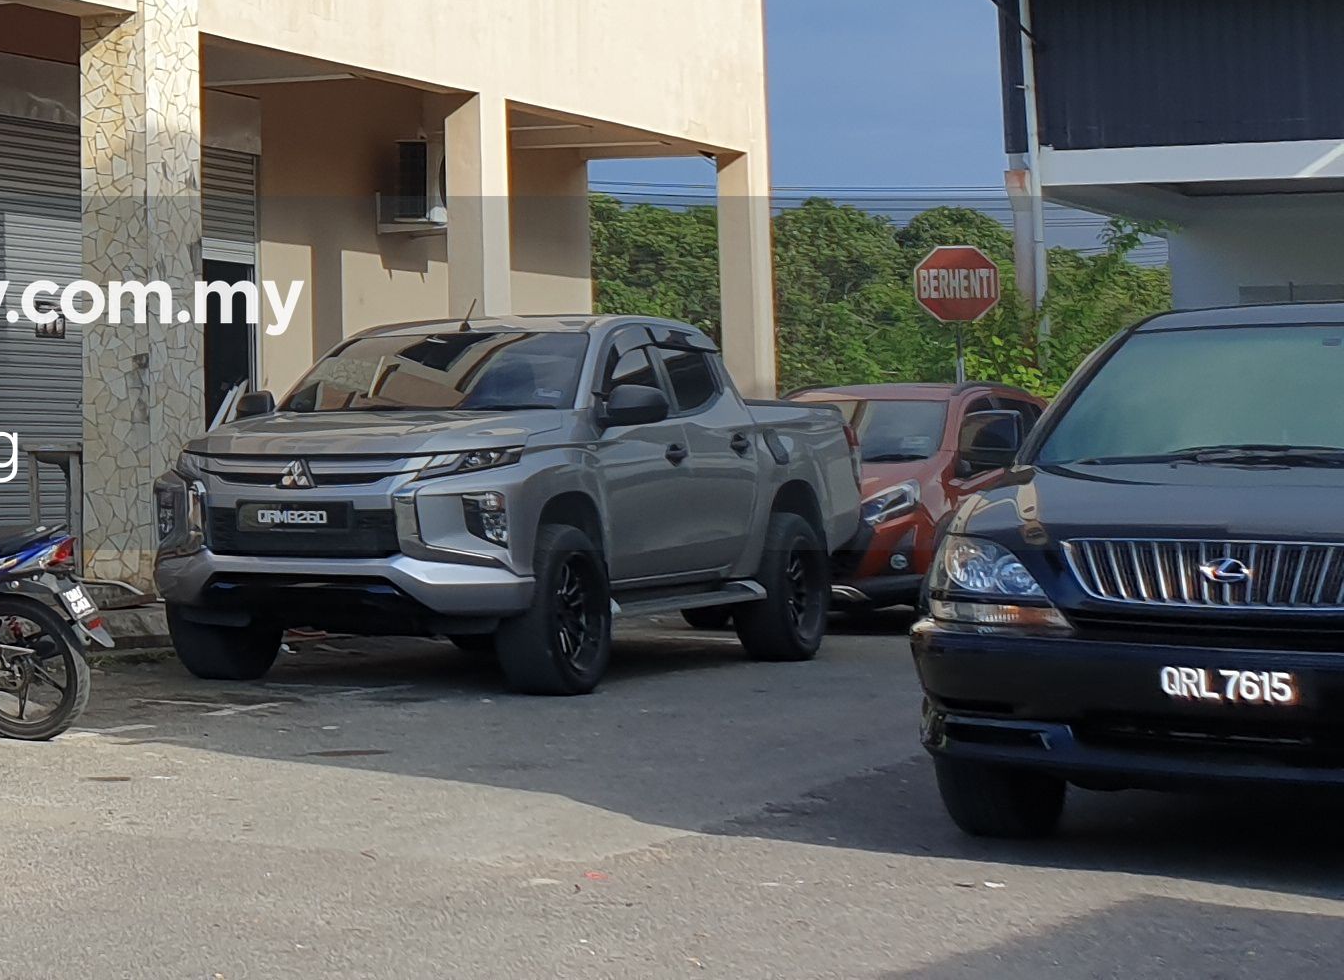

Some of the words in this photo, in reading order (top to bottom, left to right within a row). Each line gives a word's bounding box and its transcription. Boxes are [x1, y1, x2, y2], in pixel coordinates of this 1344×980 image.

[919, 268, 996, 299] BERHENTI
[1160, 666, 1220, 701] QRL
[1219, 669, 1293, 703] 7615
